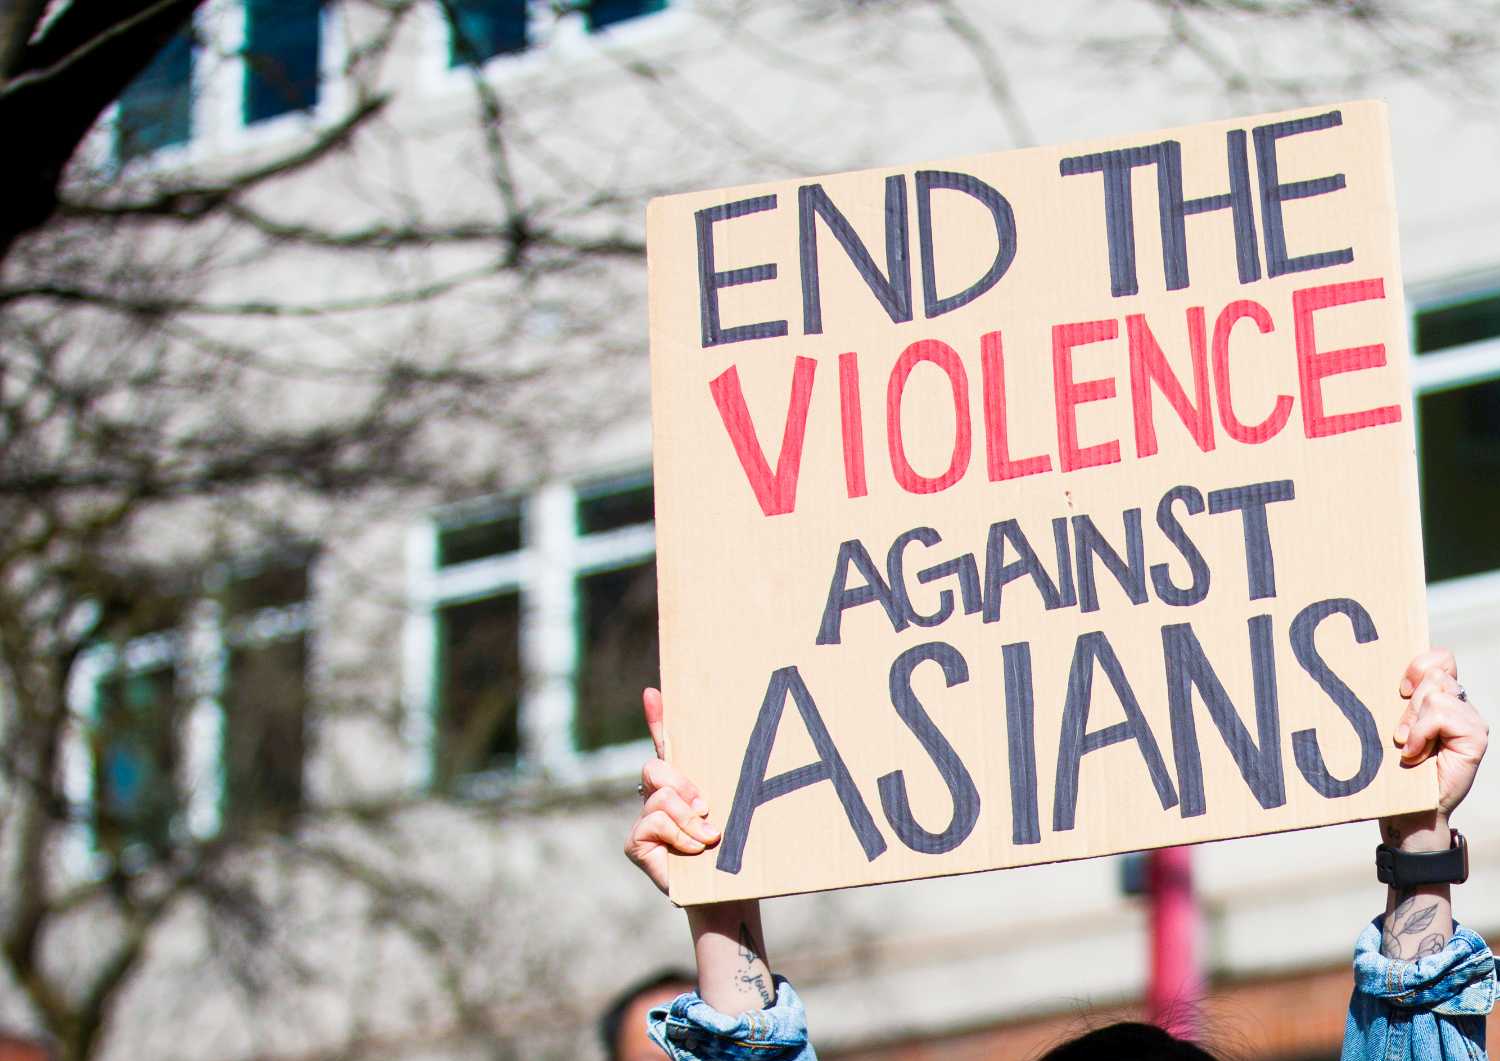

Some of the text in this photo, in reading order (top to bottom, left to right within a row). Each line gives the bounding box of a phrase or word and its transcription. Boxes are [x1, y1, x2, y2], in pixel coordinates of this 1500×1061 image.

[694, 110, 1354, 349] END THE
[708, 276, 1403, 518] VIOLENCE
[815, 479, 1296, 646] AGAINST
[715, 597, 1384, 875] ASIANS
